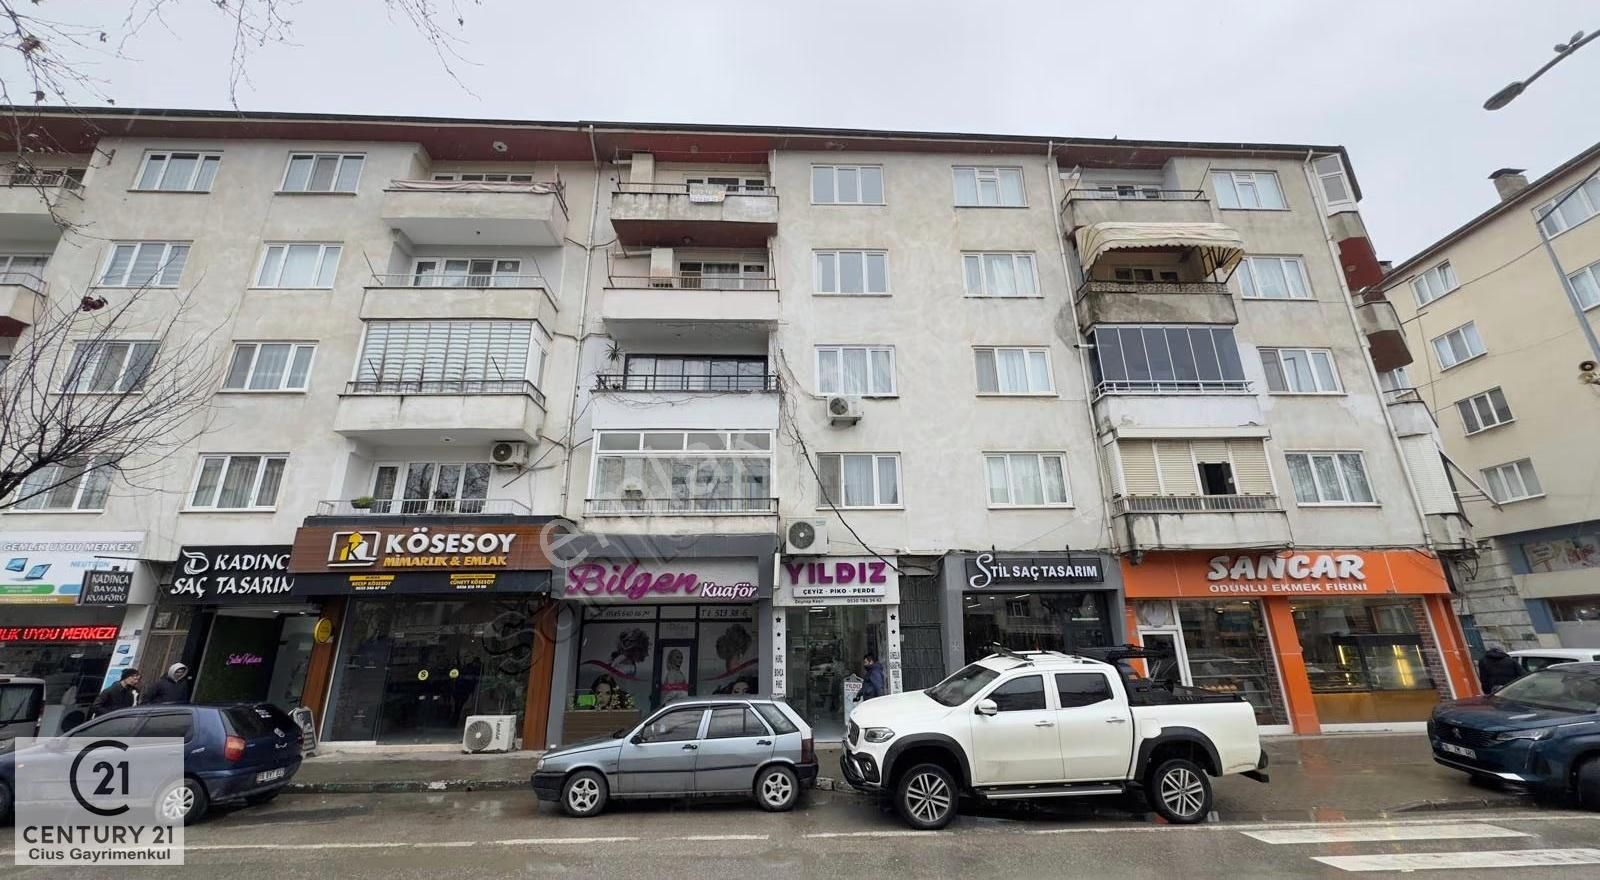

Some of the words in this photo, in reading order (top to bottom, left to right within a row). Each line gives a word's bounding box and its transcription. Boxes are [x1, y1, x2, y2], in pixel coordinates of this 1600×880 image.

[385, 527, 516, 554] KÖSESOY
[214, 553, 292, 571] KADINC
[383, 554, 448, 567] MİMARLIK
[450, 556, 461, 567] &
[464, 556, 507, 566] EMLAK
[1207, 554, 1366, 581] SANCAR
[92, 574, 129, 585] KADINCA
[565, 559, 700, 600] Bilgen
[701, 582, 757, 599] Kuaför
[784, 562, 886, 585] YILDIZ
[1012, 565, 1039, 581] SAÇ
[1041, 565, 1098, 577] TASARIM
[170, 577, 208, 598] SAÇ
[1209, 583, 1267, 593] ODUNLU
[1272, 583, 1322, 593] EKMEK
[1326, 583, 1368, 592] FIRINI
[23, 628, 60, 640] UYDU
